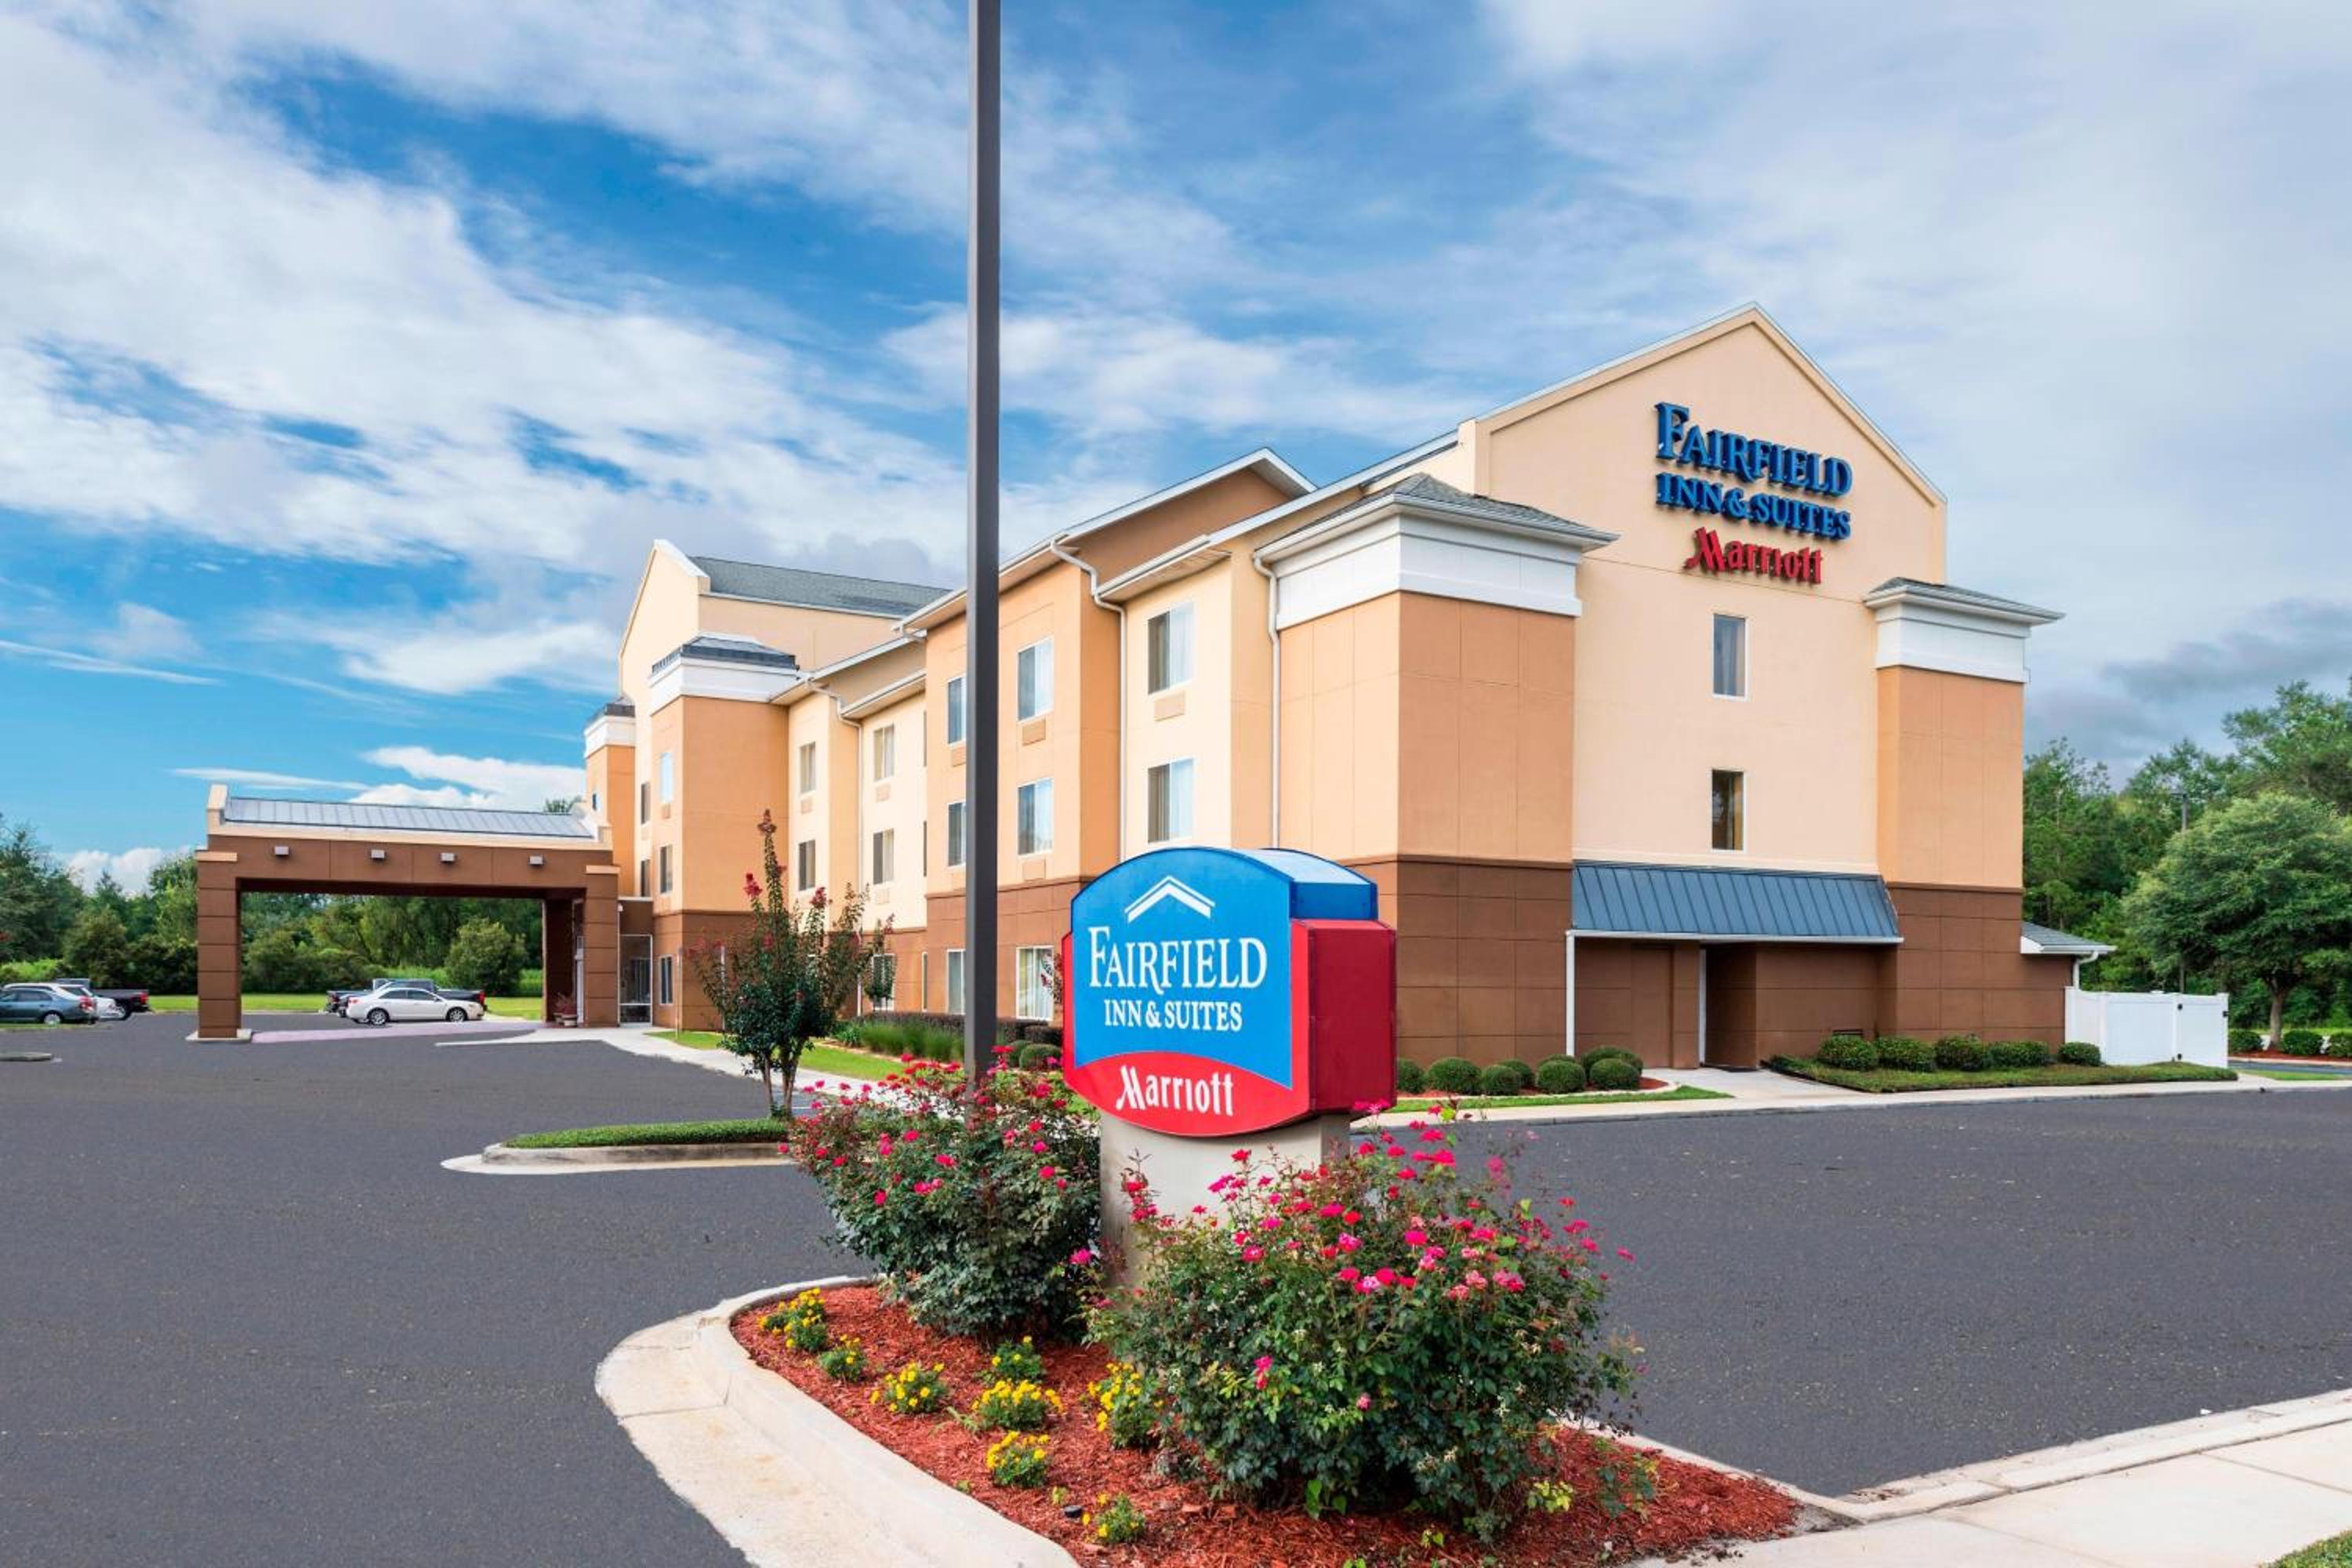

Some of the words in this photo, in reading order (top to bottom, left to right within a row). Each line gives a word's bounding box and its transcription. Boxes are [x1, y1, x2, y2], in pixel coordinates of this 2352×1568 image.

[1654, 401, 1853, 498] FAIRFIELD
[1683, 526, 1823, 584] Marriott
[1087, 925, 1268, 995] FAIRFIELD
[1115, 1064, 1234, 1117] Marriott
